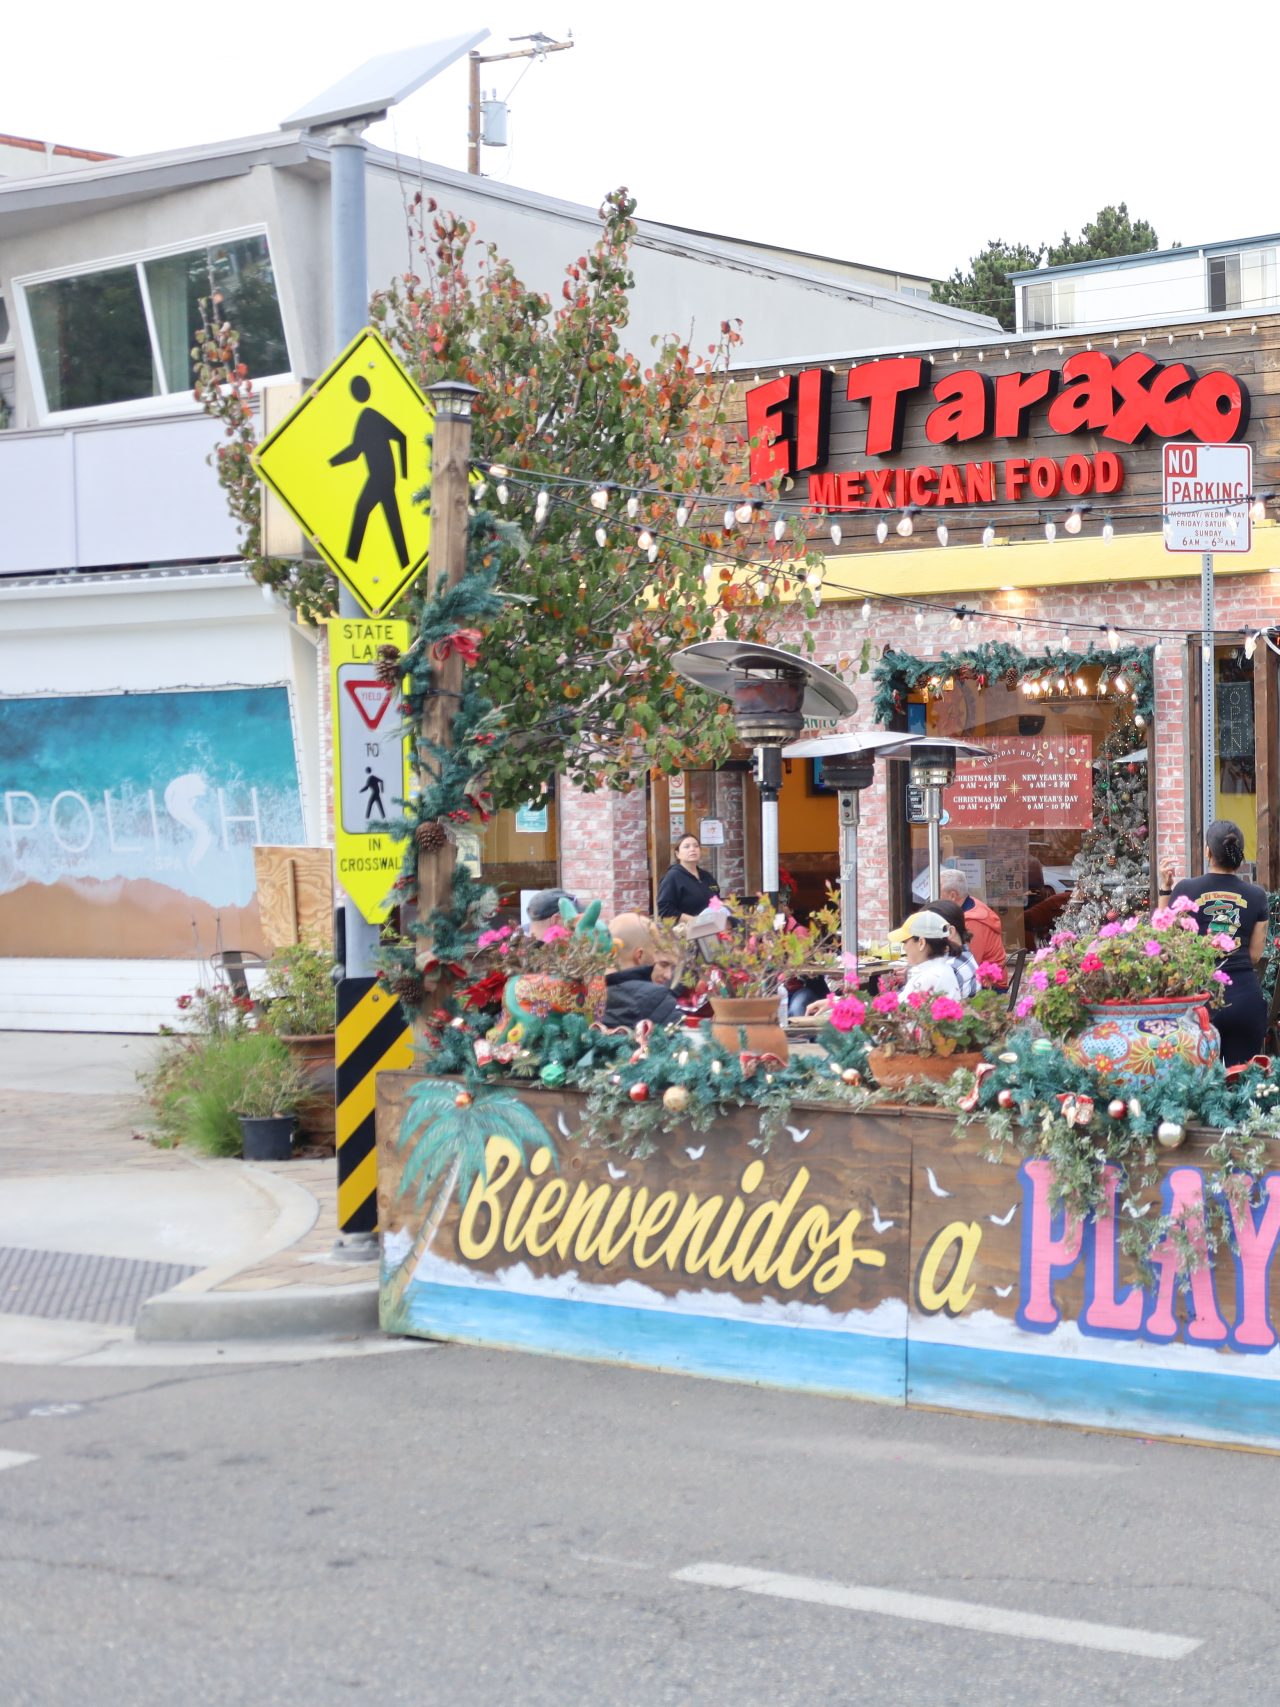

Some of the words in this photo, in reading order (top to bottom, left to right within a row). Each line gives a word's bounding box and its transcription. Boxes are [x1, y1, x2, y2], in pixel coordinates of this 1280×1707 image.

[746, 369, 829, 485] El
[847, 350, 1249, 456] Tarasco
[1168, 449, 1194, 475] NO
[808, 462, 996, 513] MEXICAN
[1005, 451, 1124, 500] FOOD
[1172, 481, 1244, 505] PARKING
[343, 624, 394, 640] STATE
[361, 692, 382, 701] YIELD
[1229, 691, 1242, 753] OPEN
[365, 743, 379, 757] TO
[983, 749, 1017, 768] HOLDAY
[1020, 750, 1046, 766] HOURS
[1064, 773, 1078, 781] EVE
[994, 795, 1008, 803] DAY
[1039, 795, 1063, 803] YEAR'S
[1065, 795, 1079, 803] DAY
[1060, 802, 1071, 810] PM
[4, 773, 262, 877] POLISH
[368, 838, 382, 851] IN
[340, 857, 403, 872] CROSSWAL
[458, 1135, 886, 1293] Bienvenidos
[918, 1219, 983, 1313] a
